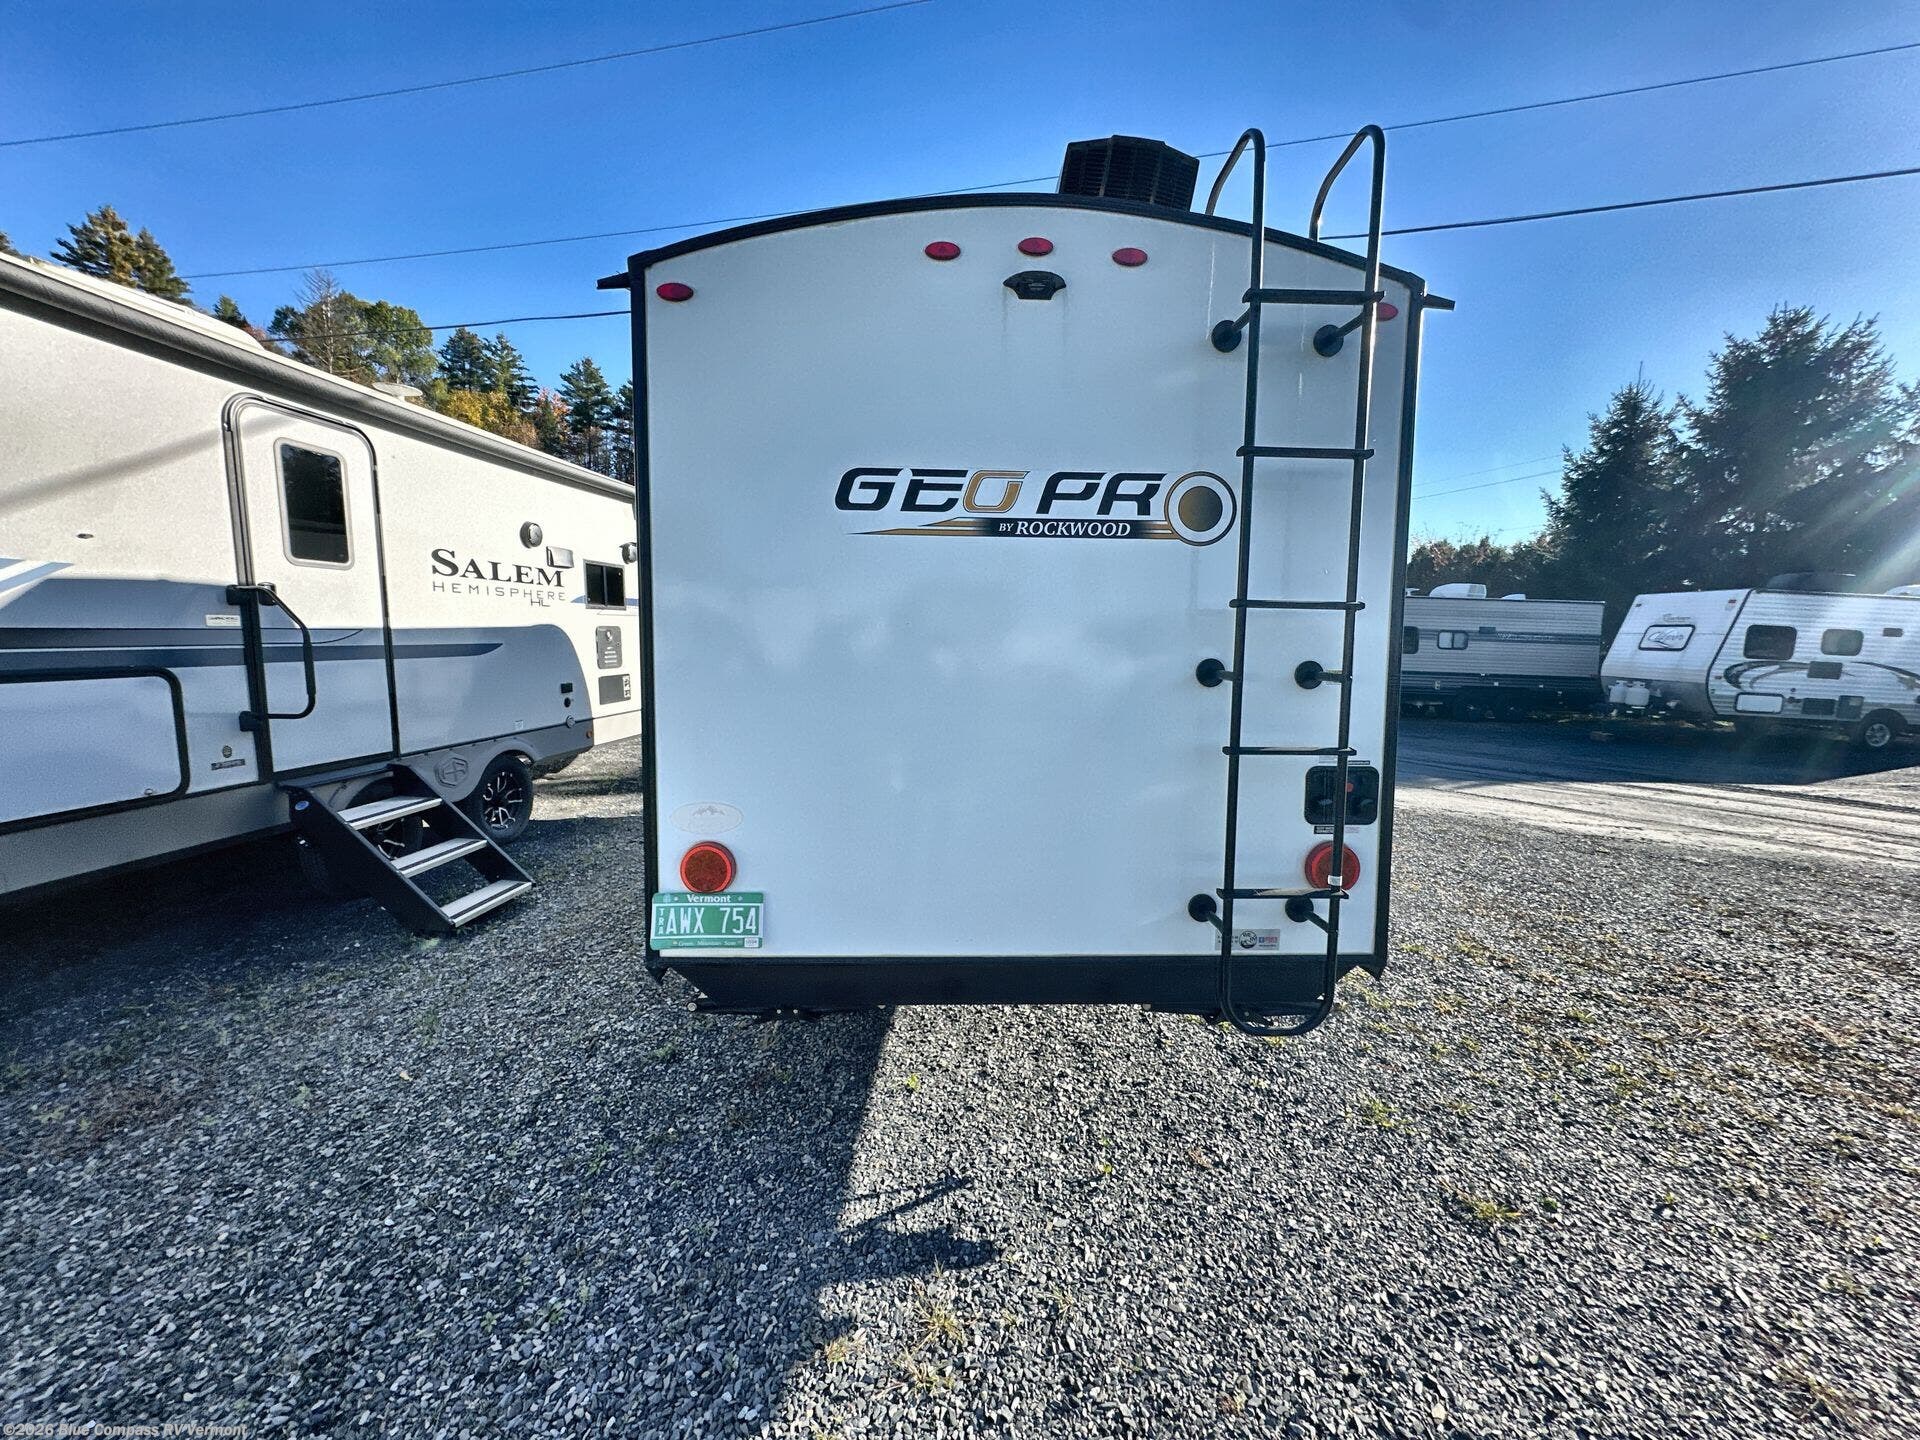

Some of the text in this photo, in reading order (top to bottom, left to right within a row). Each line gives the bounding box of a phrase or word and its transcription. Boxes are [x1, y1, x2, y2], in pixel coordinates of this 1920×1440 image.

[834, 467, 1237, 547] GEO PRO
[999, 520, 1131, 537] BY ROCKWOOD
[432, 581, 566, 601] HEMISPHERE
[686, 894, 731, 903] Vermont
[665, 907, 757, 934] AWX 754
